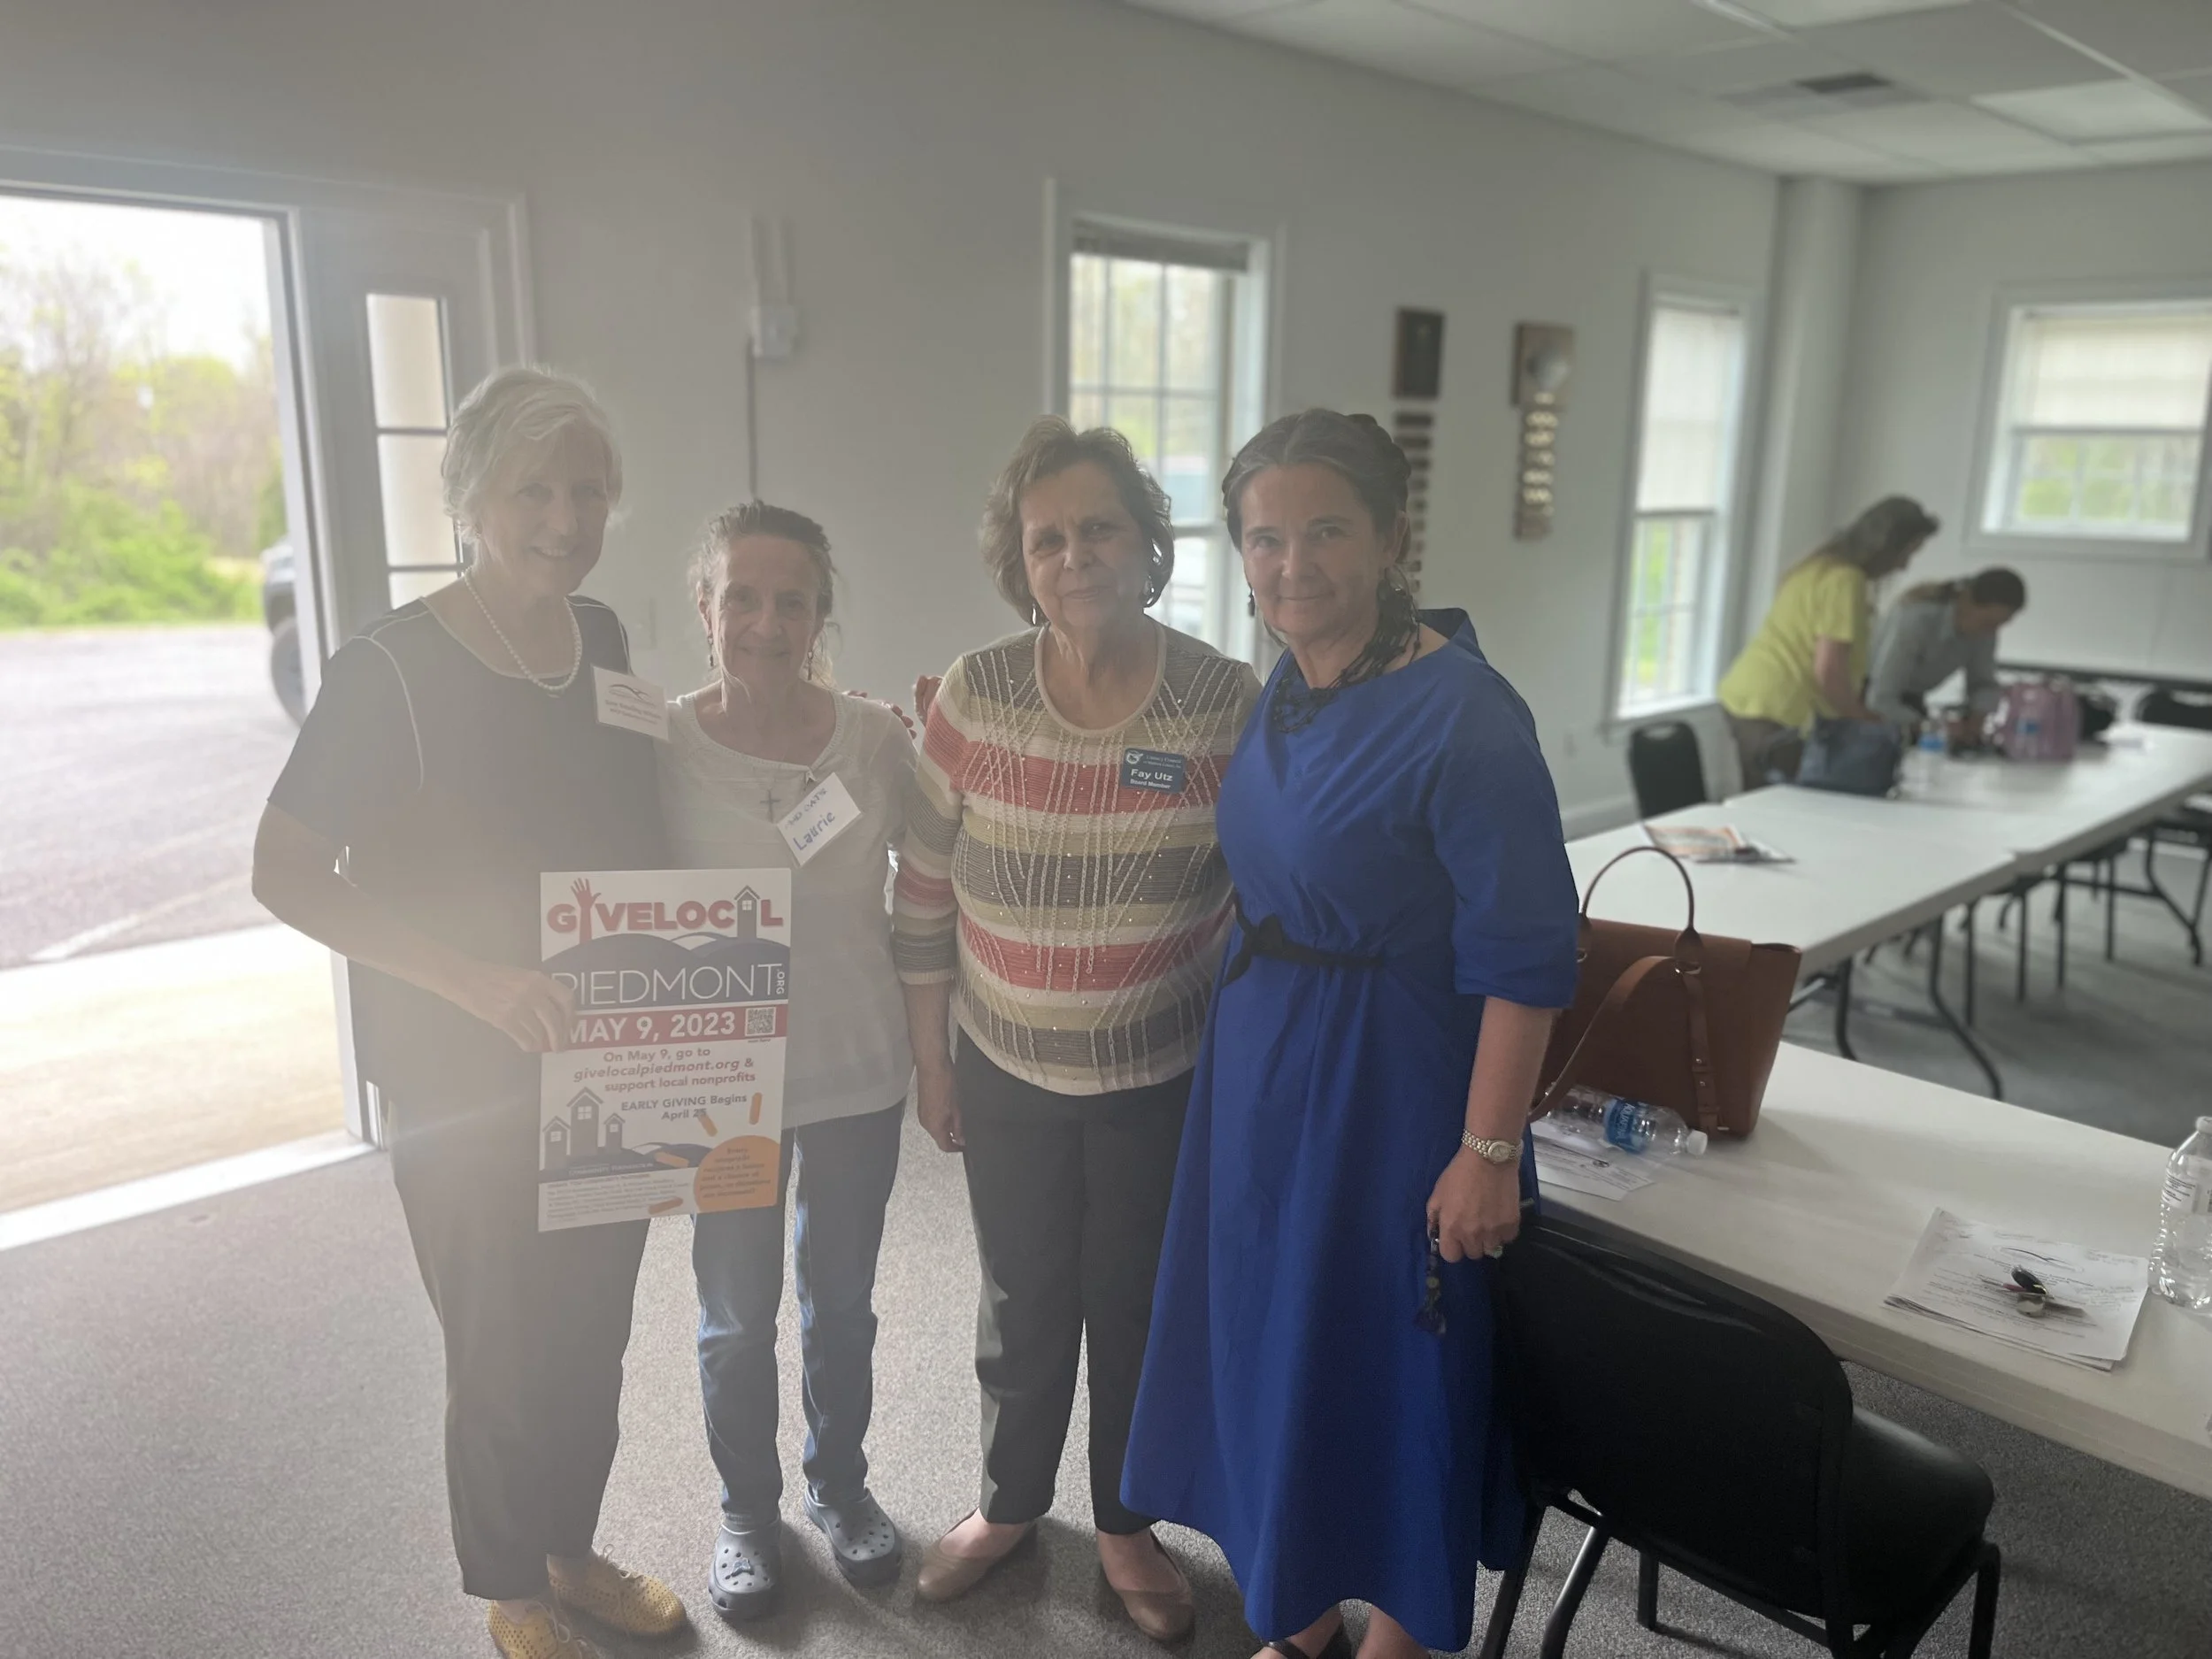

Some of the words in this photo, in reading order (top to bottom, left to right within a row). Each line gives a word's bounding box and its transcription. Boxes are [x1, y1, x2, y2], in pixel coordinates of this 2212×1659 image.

[1131, 768, 1151, 780] Fay
[1154, 772, 1173, 781] Utz
[793, 812, 835, 850] Laurie
[636, 1016, 660, 1042] 9,
[670, 1010, 737, 1037] 2023
[603, 1051, 624, 1063] On
[627, 1049, 656, 1063] May
[661, 1048, 672, 1060] 9,
[676, 1049, 693, 1061] go
[697, 1048, 710, 1057] to
[573, 1057, 740, 1082] givelocalpiedmont.org
[744, 1057, 754, 1068] &
[604, 1080, 655, 1094] support
[659, 1076, 687, 1088] local
[692, 1072, 756, 1087] nonprofits
[621, 1100, 659, 1111] EARLY
[663, 1096, 707, 1108] GIVING
[710, 1094, 748, 1106] Begins
[661, 1109, 689, 1121] April
